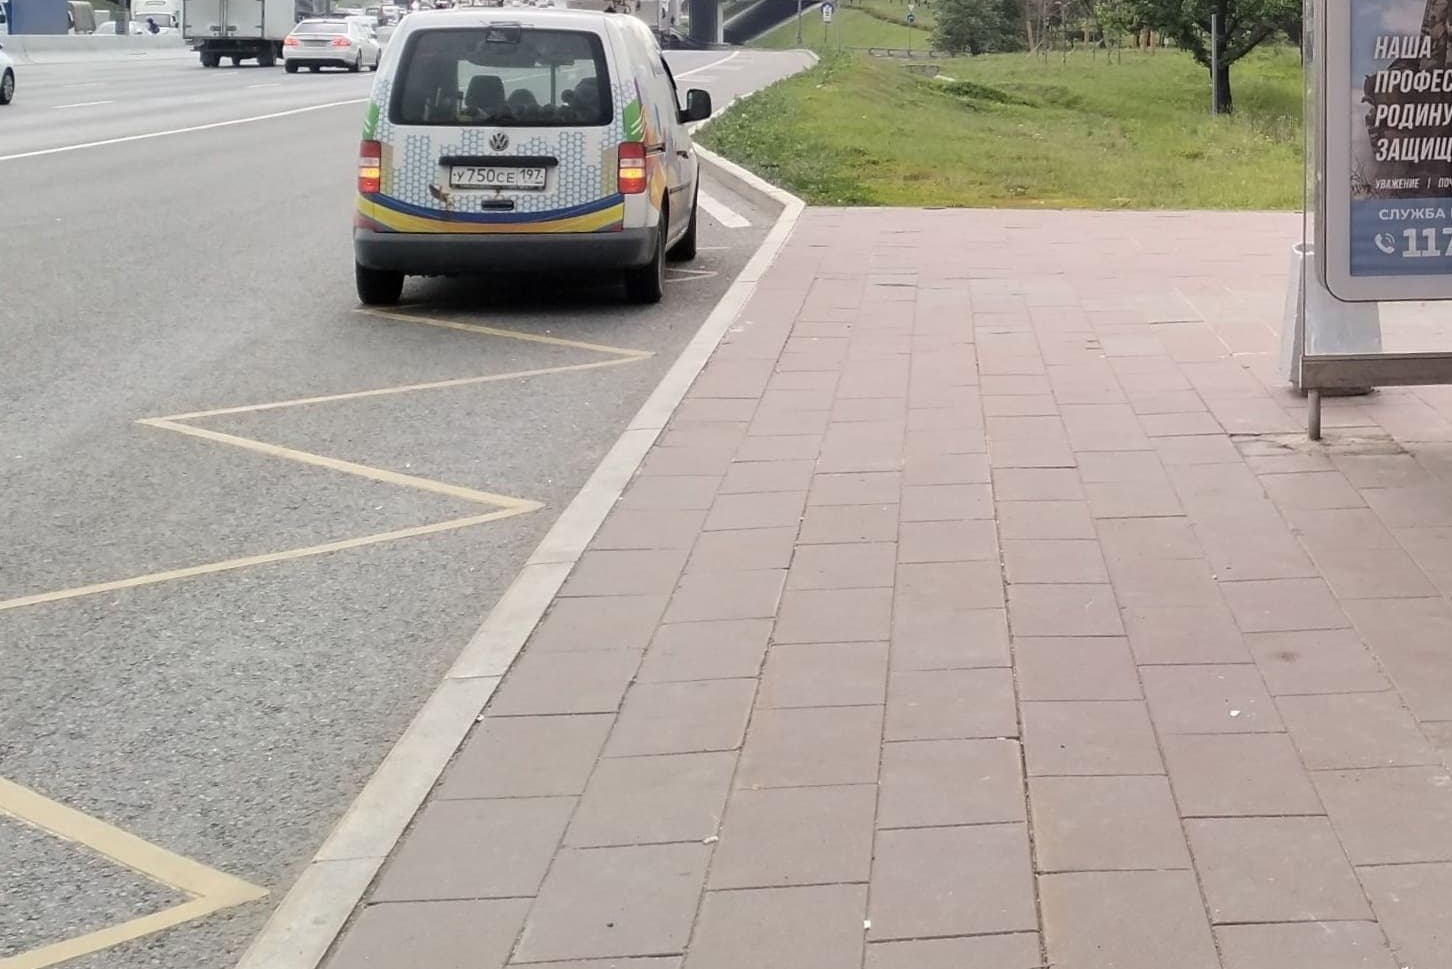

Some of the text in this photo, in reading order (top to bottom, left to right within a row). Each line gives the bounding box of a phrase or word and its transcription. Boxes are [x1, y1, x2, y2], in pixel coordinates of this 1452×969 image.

[1375, 35, 1432, 60] НАША
[1375, 178, 1420, 189] УВАЖЕНИЕ
[1379, 207, 1446, 220] СЛУЖБА
